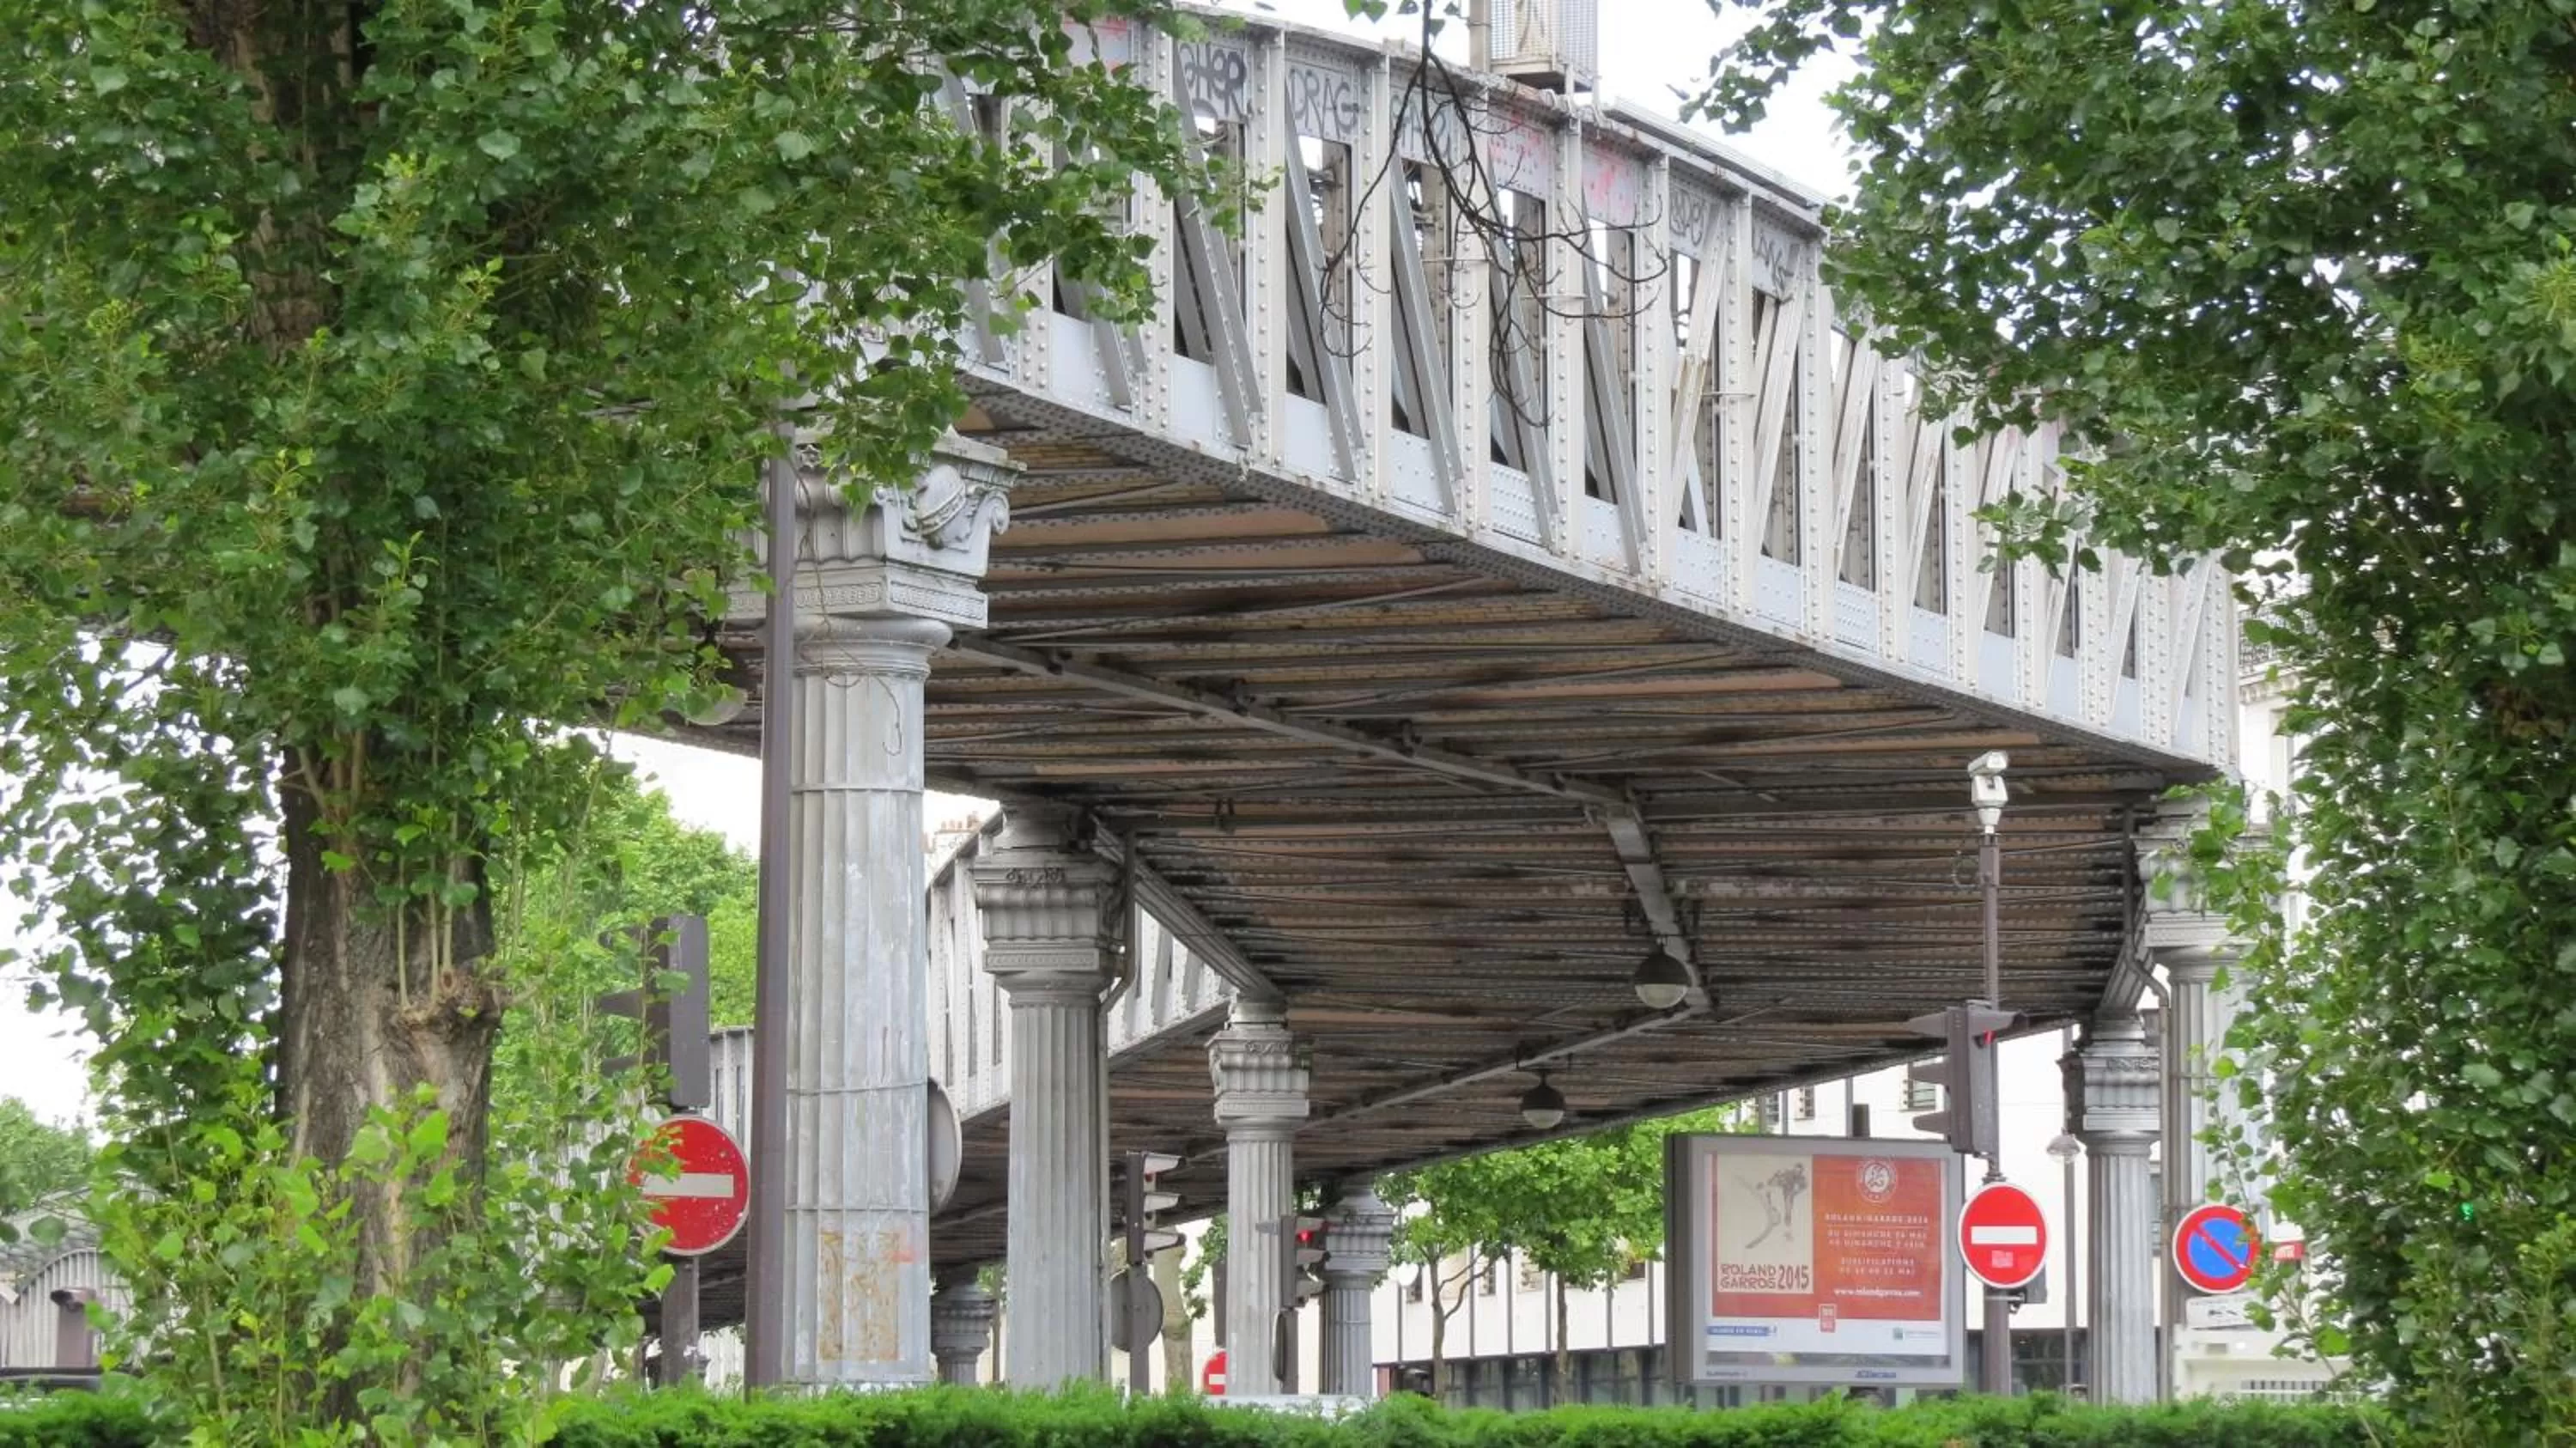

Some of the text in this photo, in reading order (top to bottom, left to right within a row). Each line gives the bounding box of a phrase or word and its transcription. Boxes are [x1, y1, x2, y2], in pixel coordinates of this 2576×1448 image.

[1720, 1263, 1777, 1277] ROLAND
[1777, 1263, 1810, 1290] 2015
[1720, 1276, 1777, 1289] GARROS
